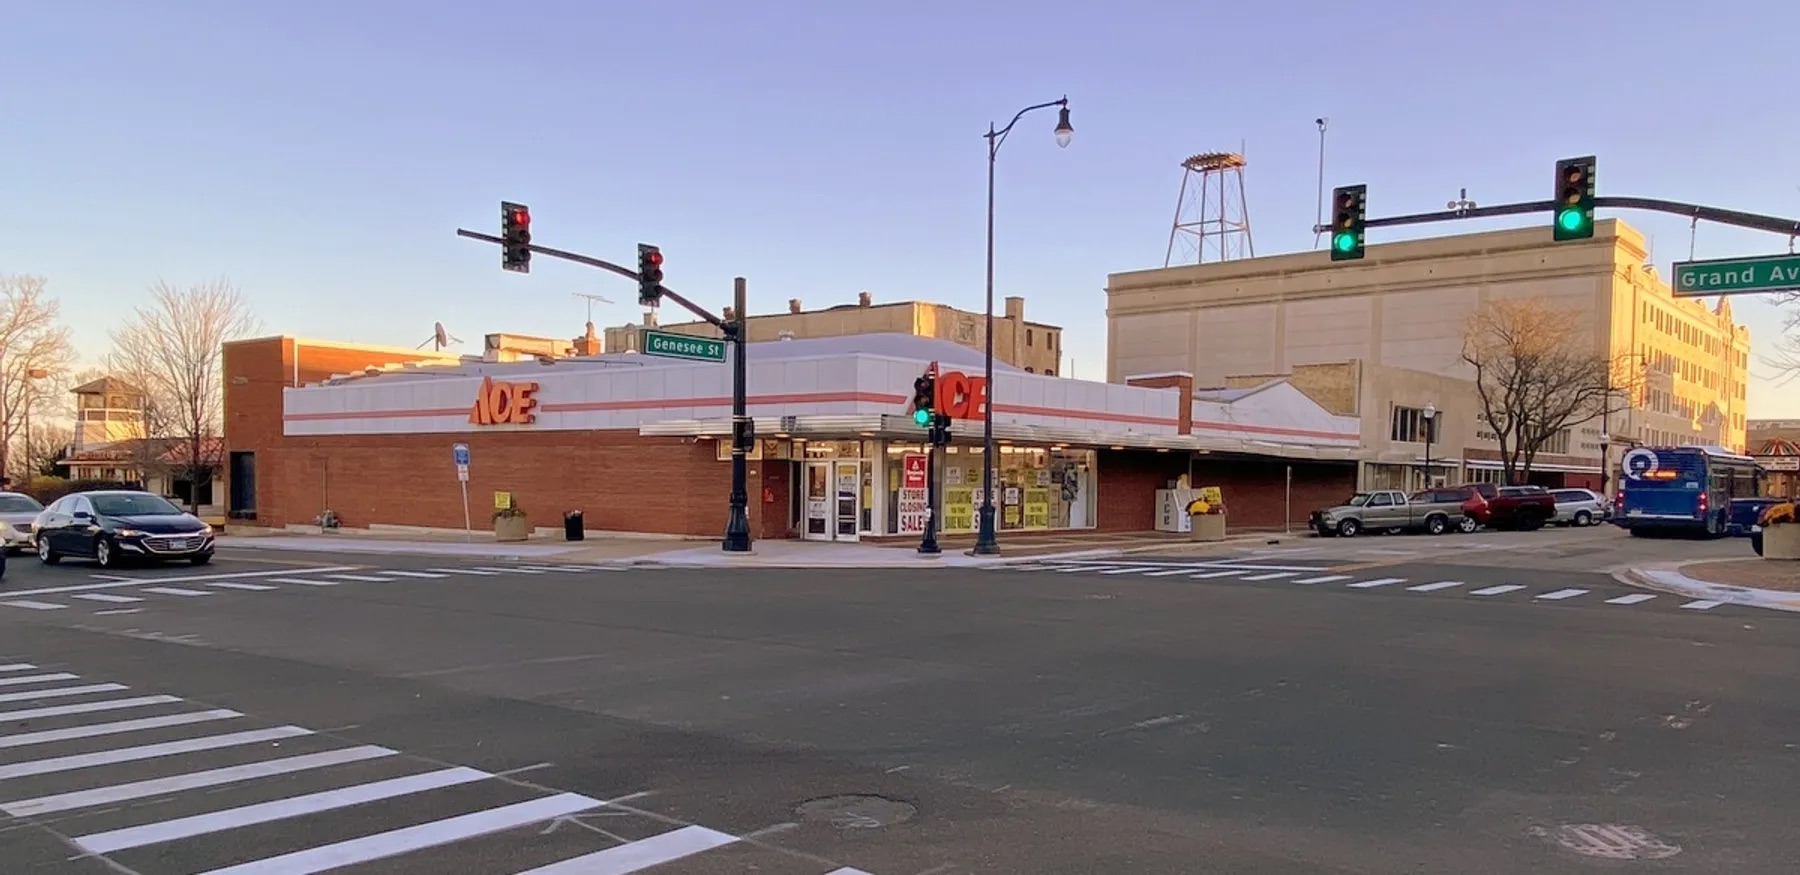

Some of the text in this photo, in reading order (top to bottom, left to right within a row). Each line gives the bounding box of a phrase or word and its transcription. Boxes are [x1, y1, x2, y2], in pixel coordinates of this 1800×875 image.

[1682, 266, 1754, 286] Grand
[653, 338, 719, 356] Genesee St
[468, 376, 539, 425] ACE
[903, 489, 924, 500] STORE
